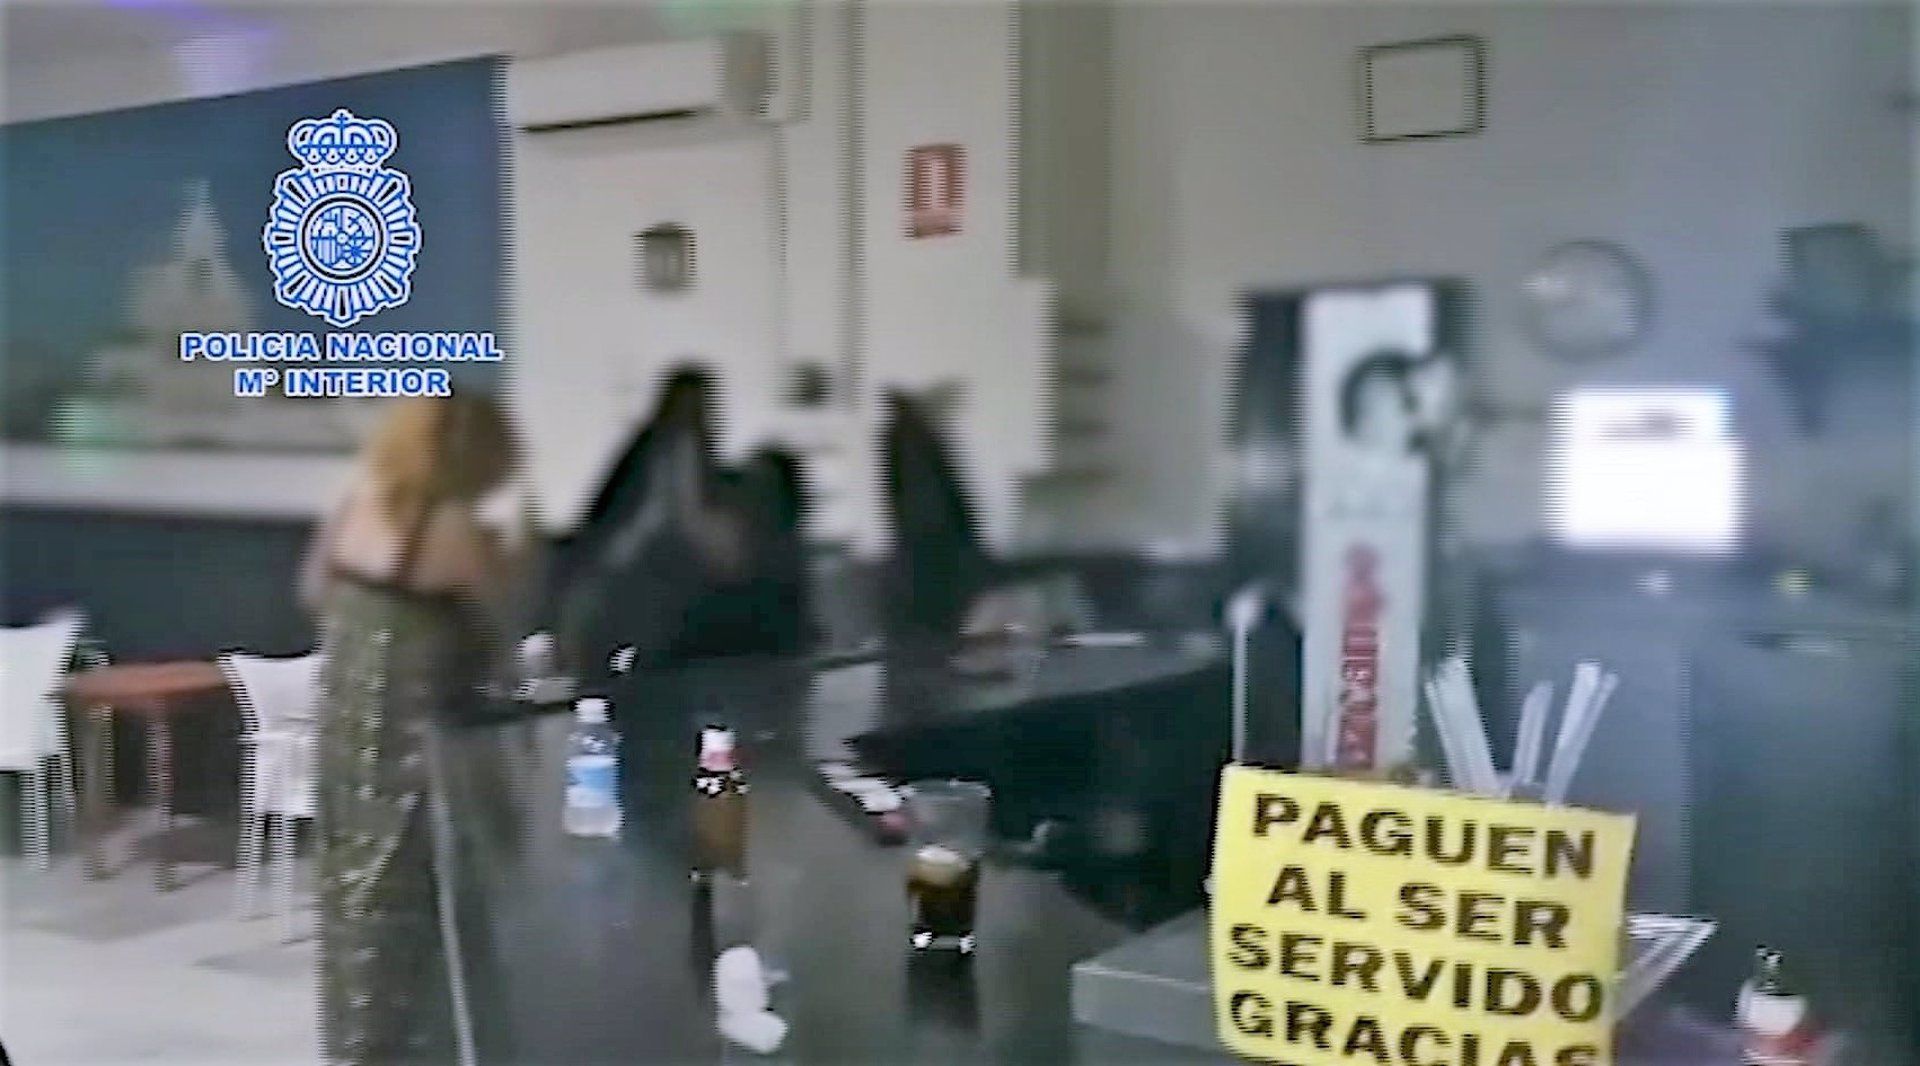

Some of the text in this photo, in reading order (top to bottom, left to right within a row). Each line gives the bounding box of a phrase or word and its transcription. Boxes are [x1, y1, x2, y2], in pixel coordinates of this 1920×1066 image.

[1253, 793, 1596, 879] PAGUEN
[1266, 864, 1571, 949] AL SER
[1228, 923, 1603, 1024] SERVIDO
